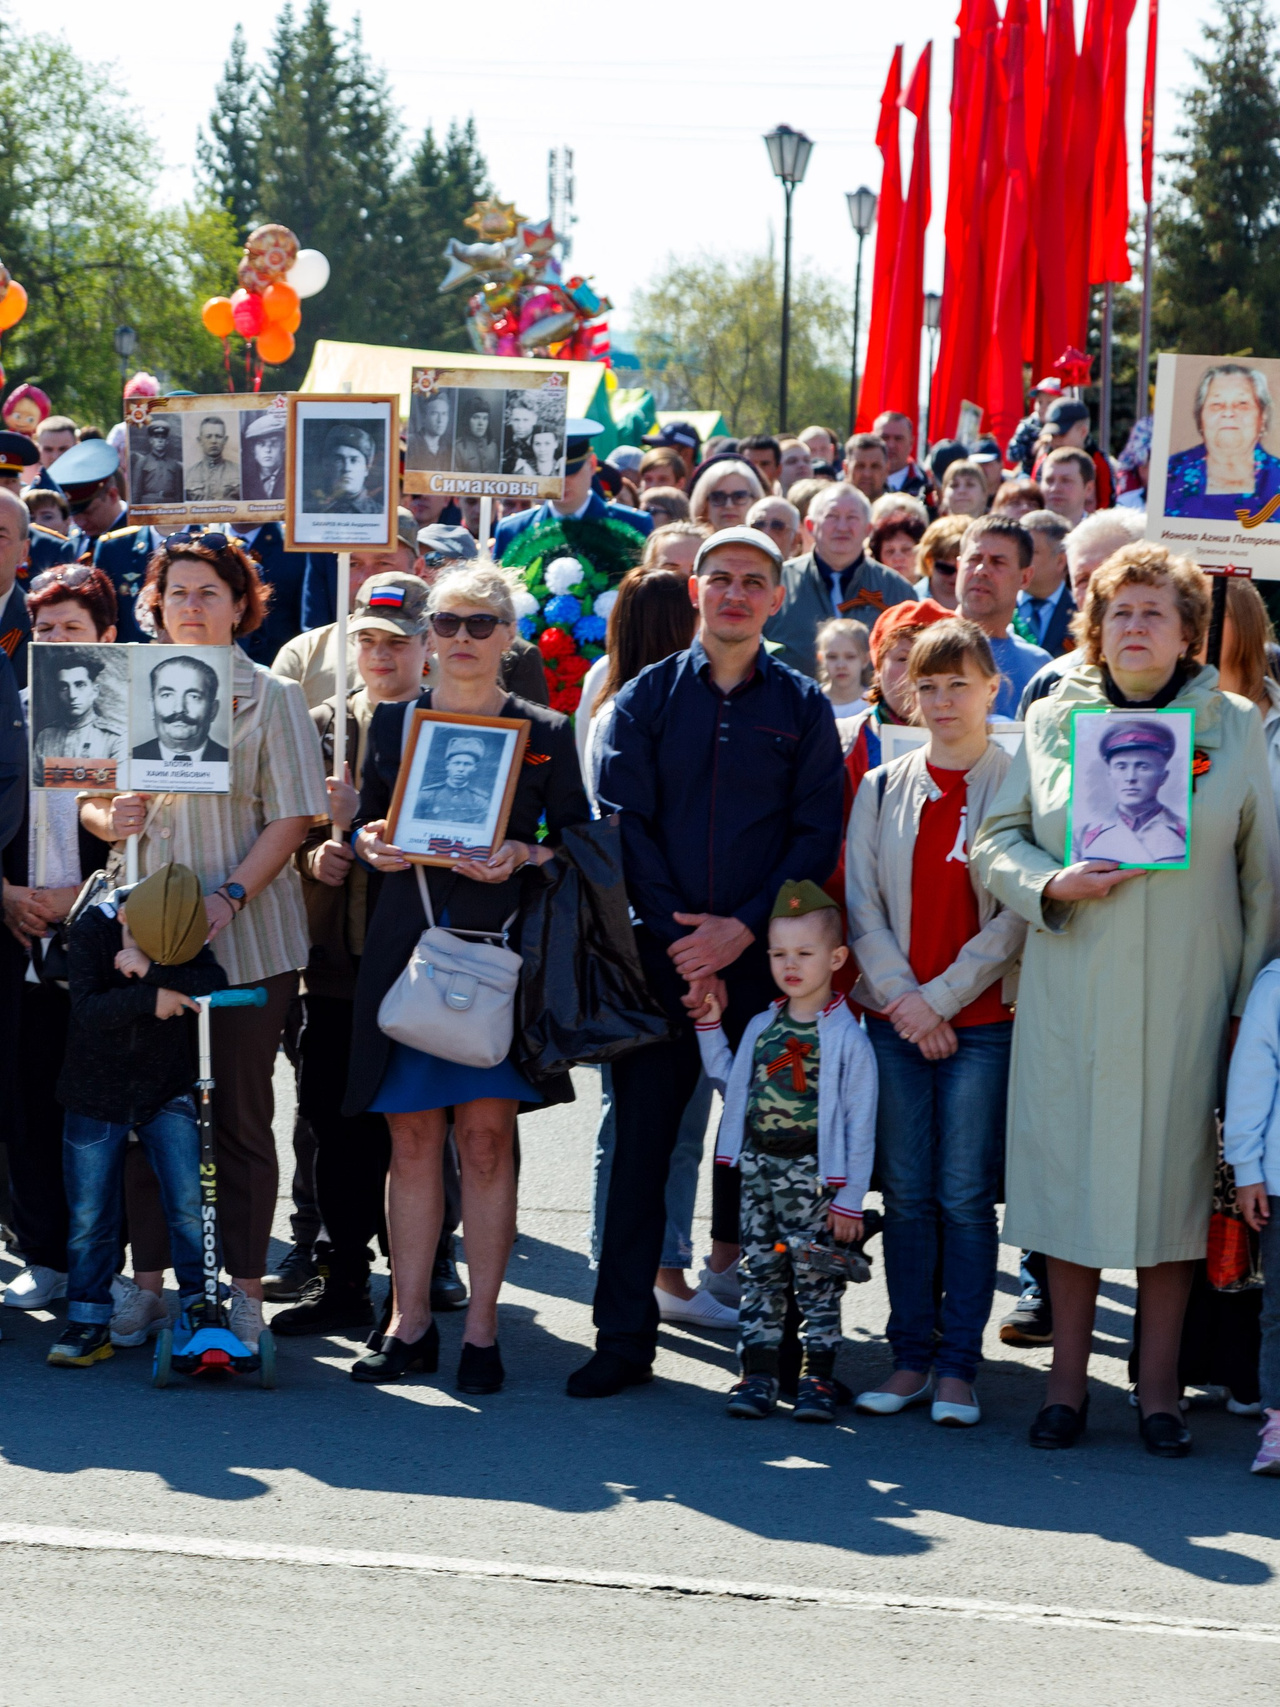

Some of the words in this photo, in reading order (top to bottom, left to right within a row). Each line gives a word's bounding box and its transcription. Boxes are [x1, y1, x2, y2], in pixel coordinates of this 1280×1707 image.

[429, 474, 539, 496] Симаковы
[1160, 529, 1198, 541] Ионова
[1200, 532, 1232, 543] Агния
[170, 769, 211, 778] ЛЕЙБОВИЧ
